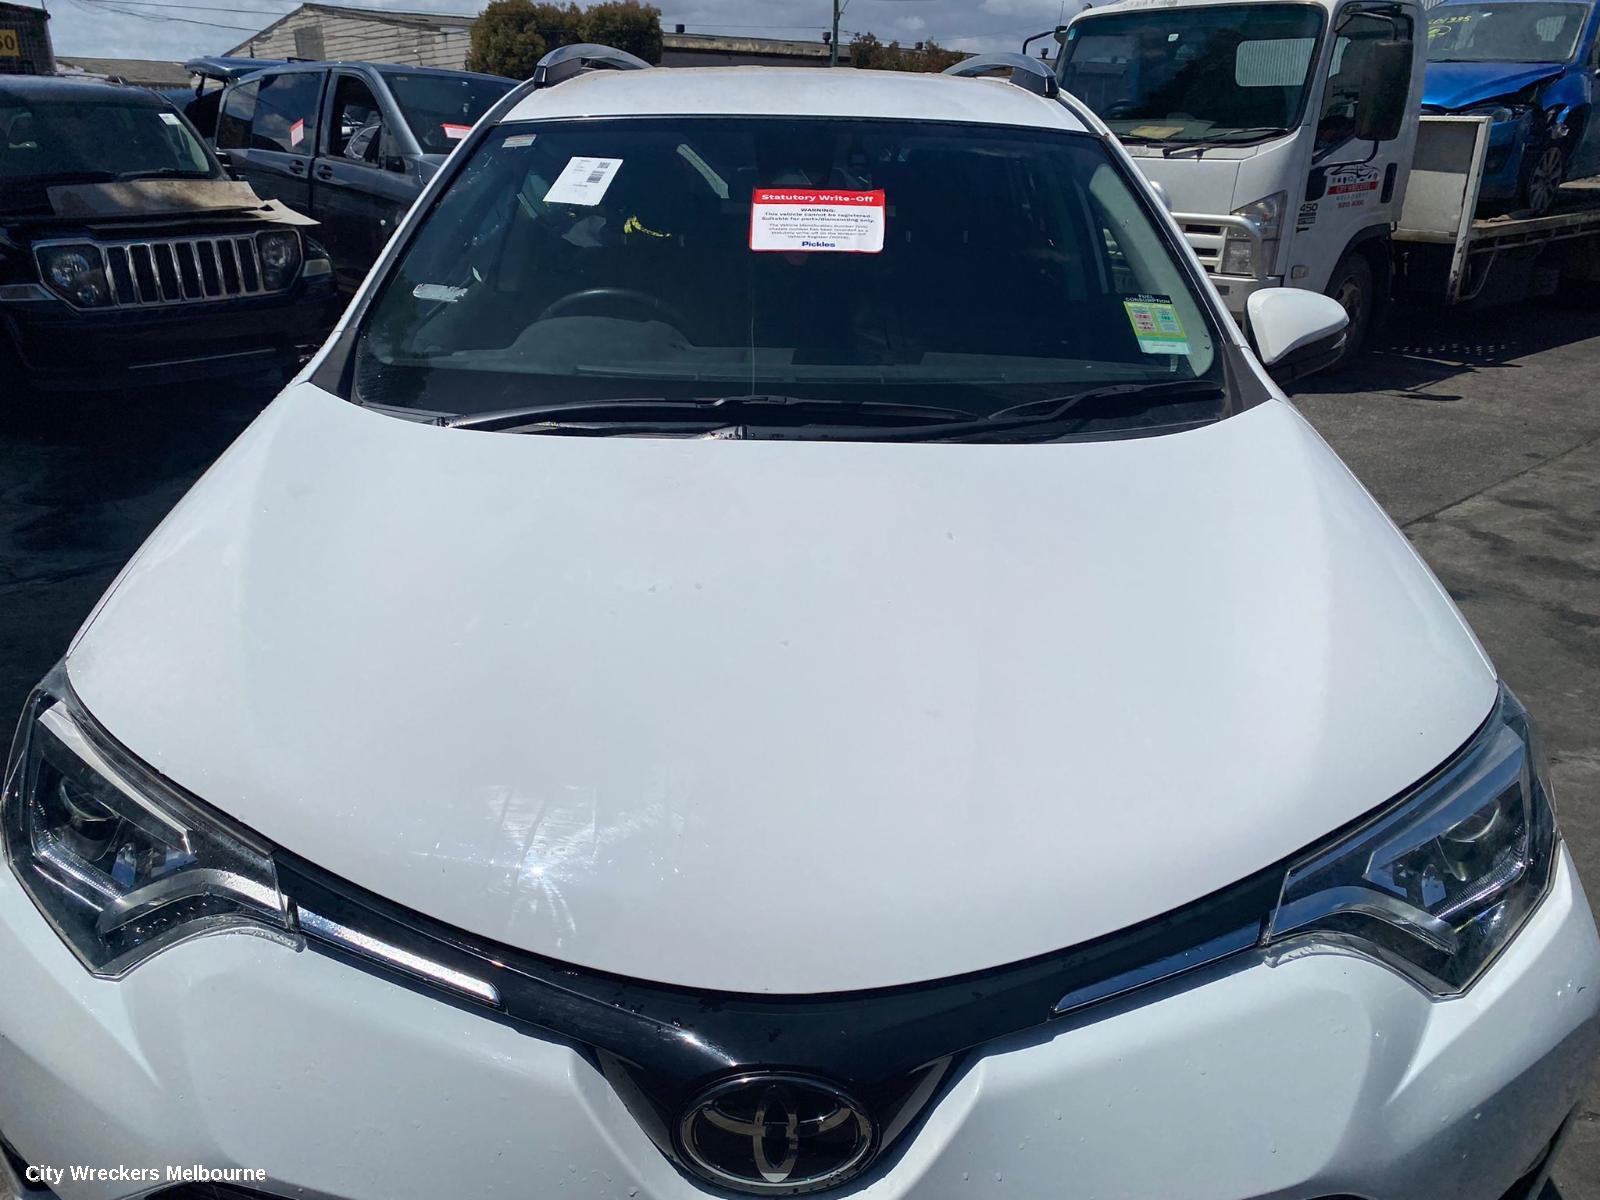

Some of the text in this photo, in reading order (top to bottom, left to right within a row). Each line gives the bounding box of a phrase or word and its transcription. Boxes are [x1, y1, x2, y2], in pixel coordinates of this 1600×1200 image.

[761, 194, 874, 202] Statutory Write-Off
[1300, 203, 1318, 212] 450
